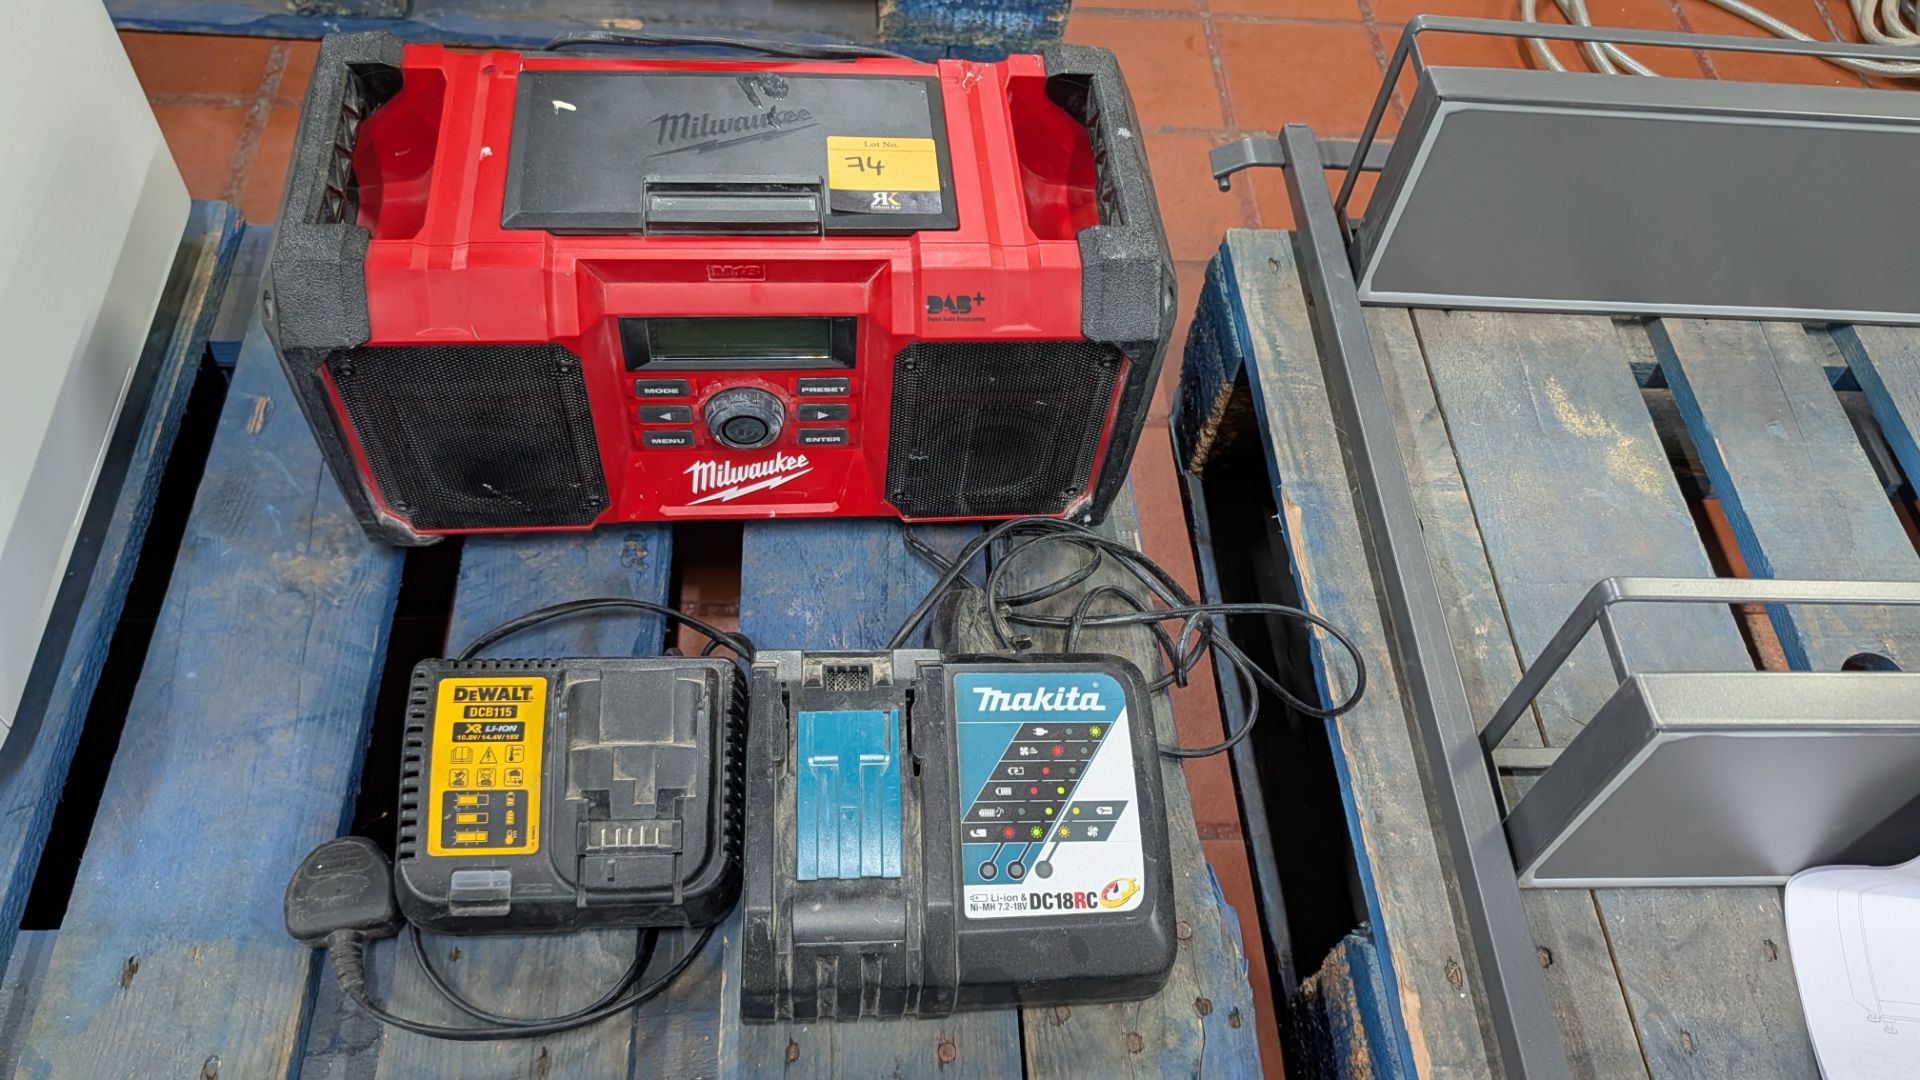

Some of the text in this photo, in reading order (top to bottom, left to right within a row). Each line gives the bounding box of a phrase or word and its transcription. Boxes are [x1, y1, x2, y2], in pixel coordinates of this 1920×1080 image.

[845, 156, 886, 176] 74
[683, 452, 810, 494] Milwaukee
[470, 707, 512, 717] DCB115
[464, 723, 518, 734] XR LI-ION
[991, 894, 1027, 902] Li-ion &
[1030, 892, 1098, 910] DC18RC
[970, 902, 1028, 911] Ni-MH 7.2-18V
